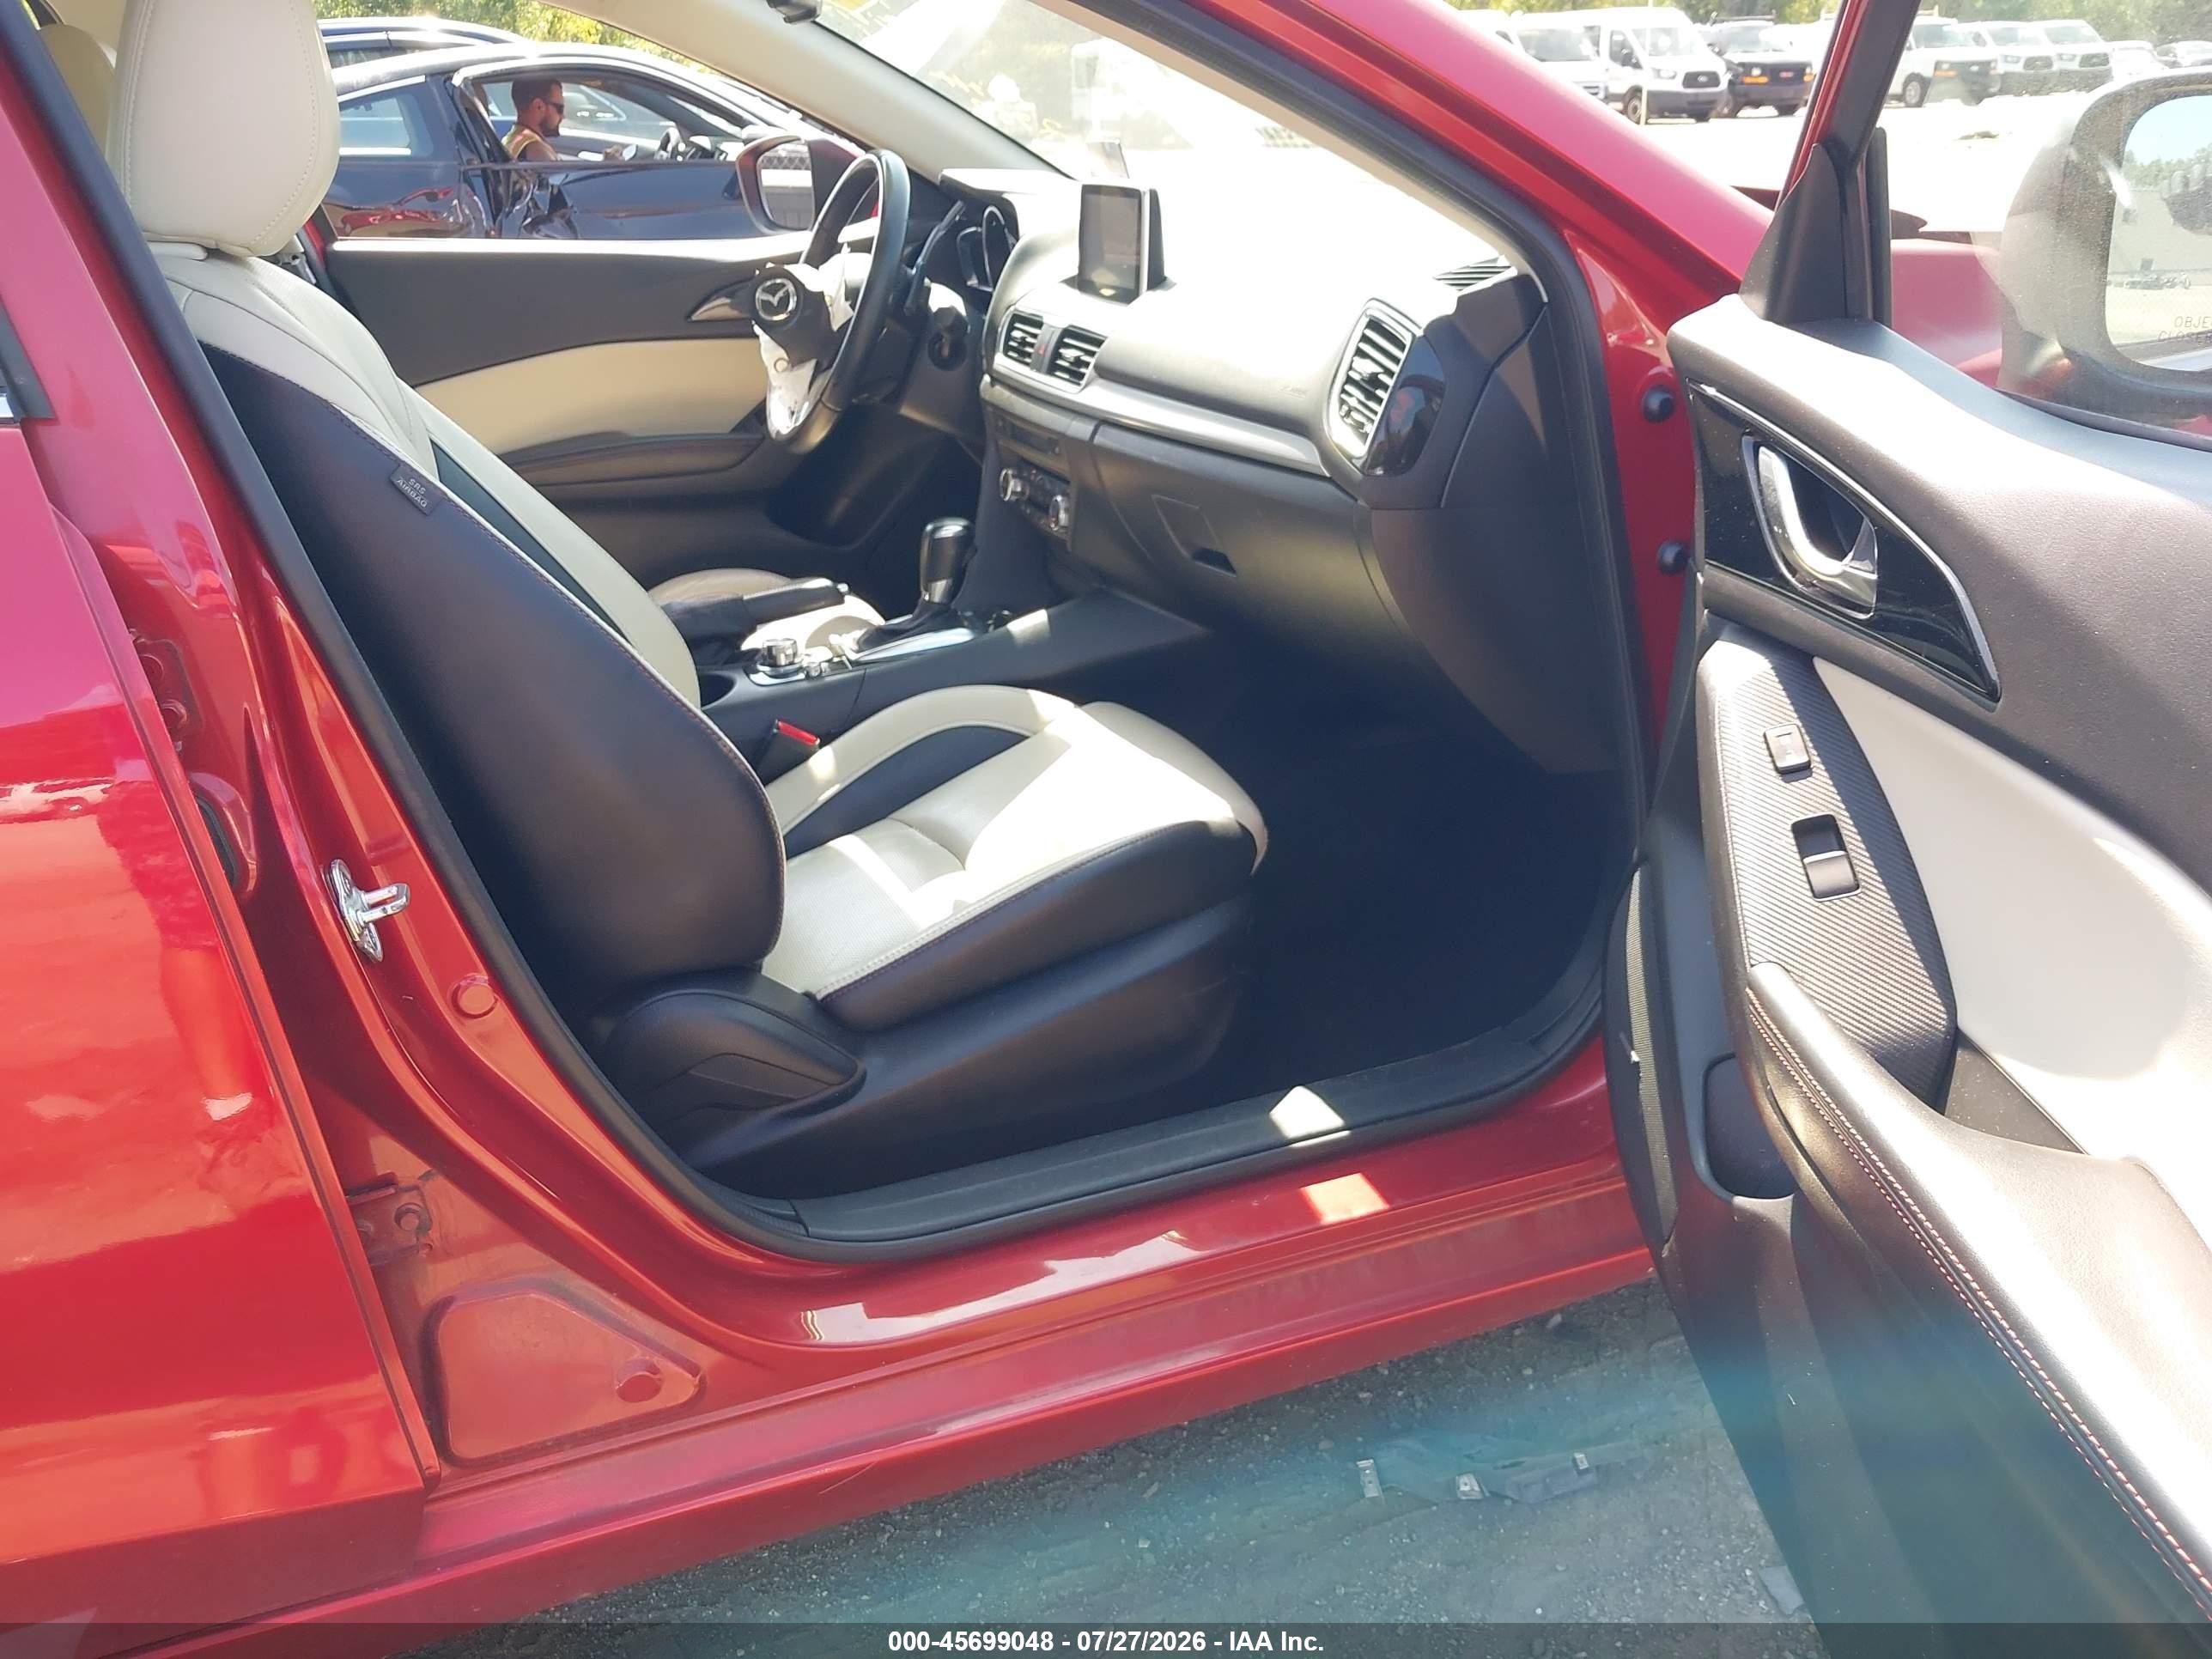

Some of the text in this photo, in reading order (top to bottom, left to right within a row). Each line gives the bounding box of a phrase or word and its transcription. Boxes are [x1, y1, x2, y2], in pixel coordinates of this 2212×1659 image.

[2173, 315, 2212, 328] OBJE
[397, 479, 428, 508] AIRBAG
[408, 477, 427, 495] SRS
